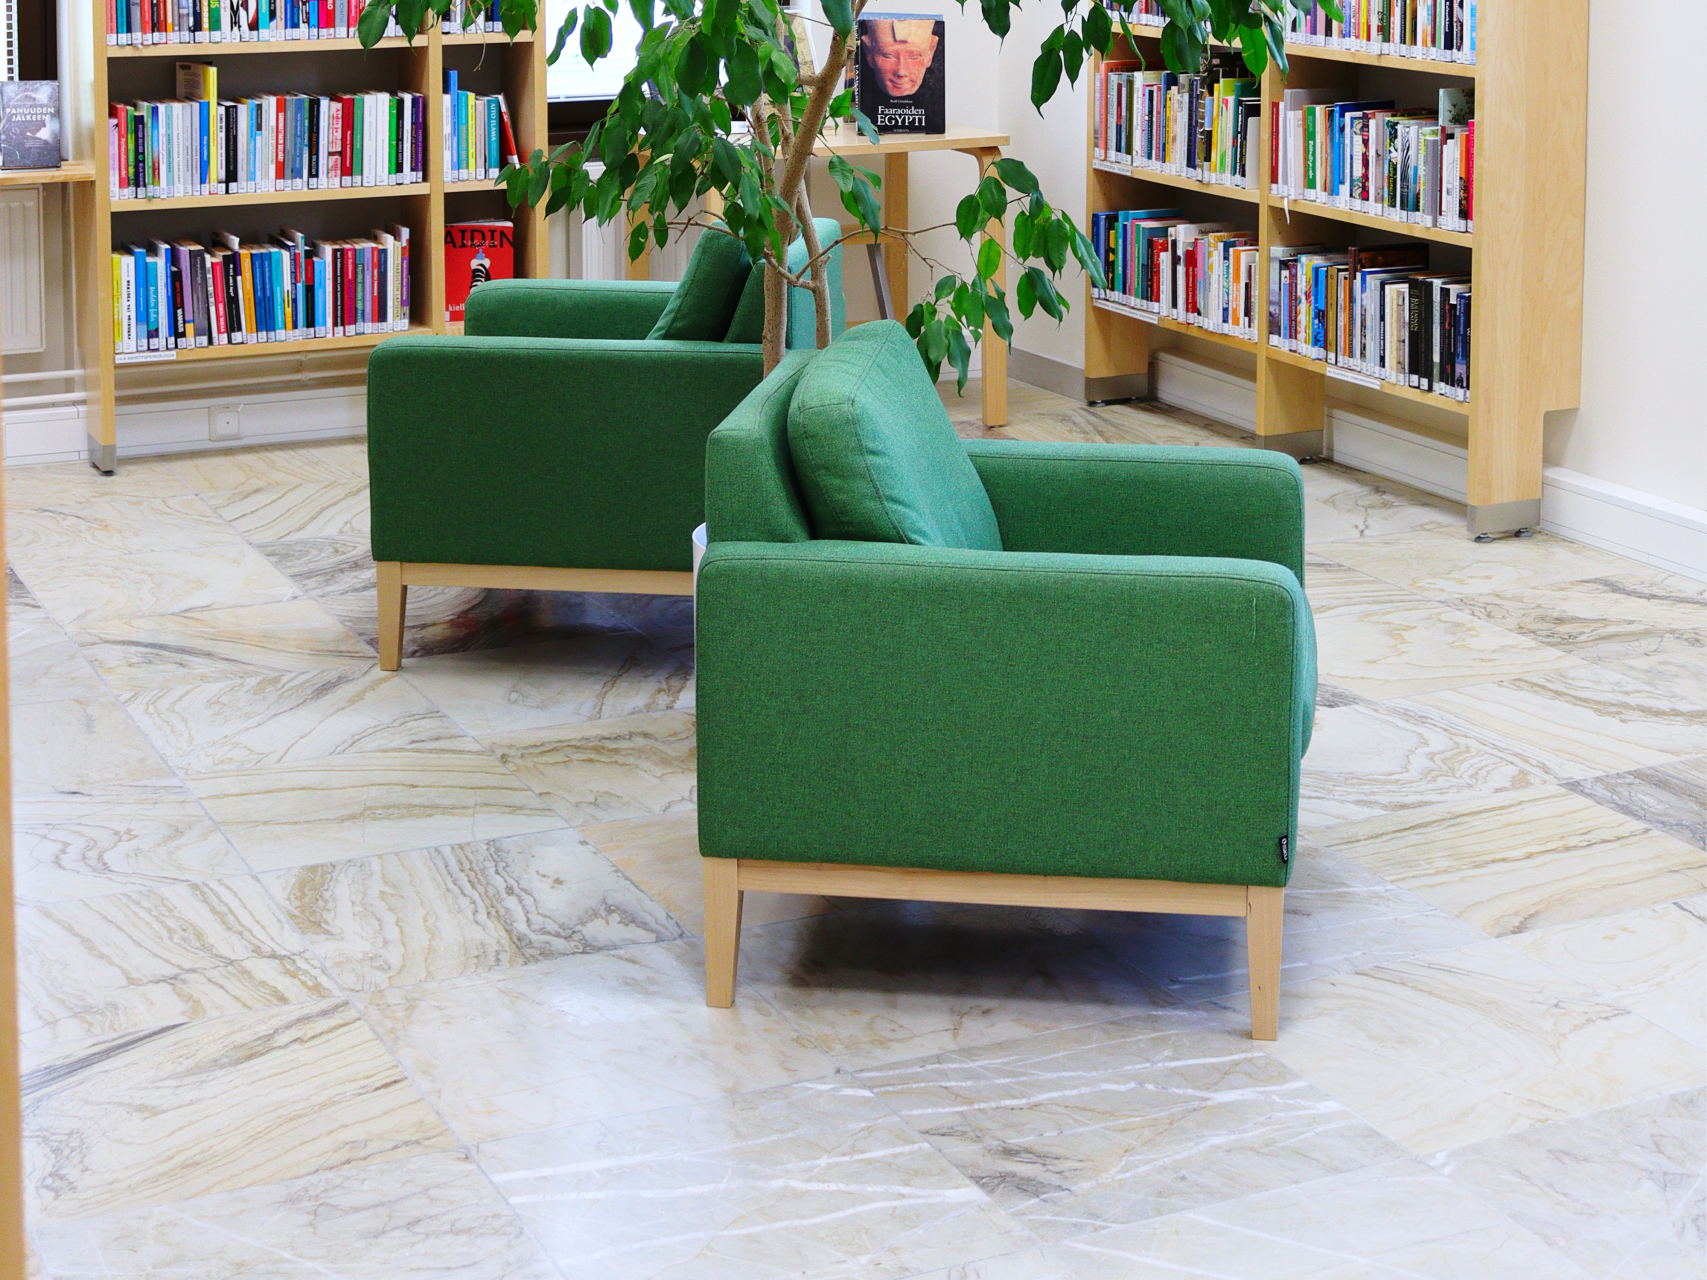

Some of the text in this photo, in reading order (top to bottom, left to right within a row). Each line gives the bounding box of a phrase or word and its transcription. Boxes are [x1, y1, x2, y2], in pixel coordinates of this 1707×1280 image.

[5, 107, 55, 115] PAHUUDEN
[878, 105, 925, 115] Faaraoiden
[11, 114, 49, 122] JÄLKEEN
[877, 114, 926, 126] EGYPTI
[334, 126, 340, 134] ja
[444, 225, 514, 248] ÄIDIN
[448, 303, 465, 312] kiell
